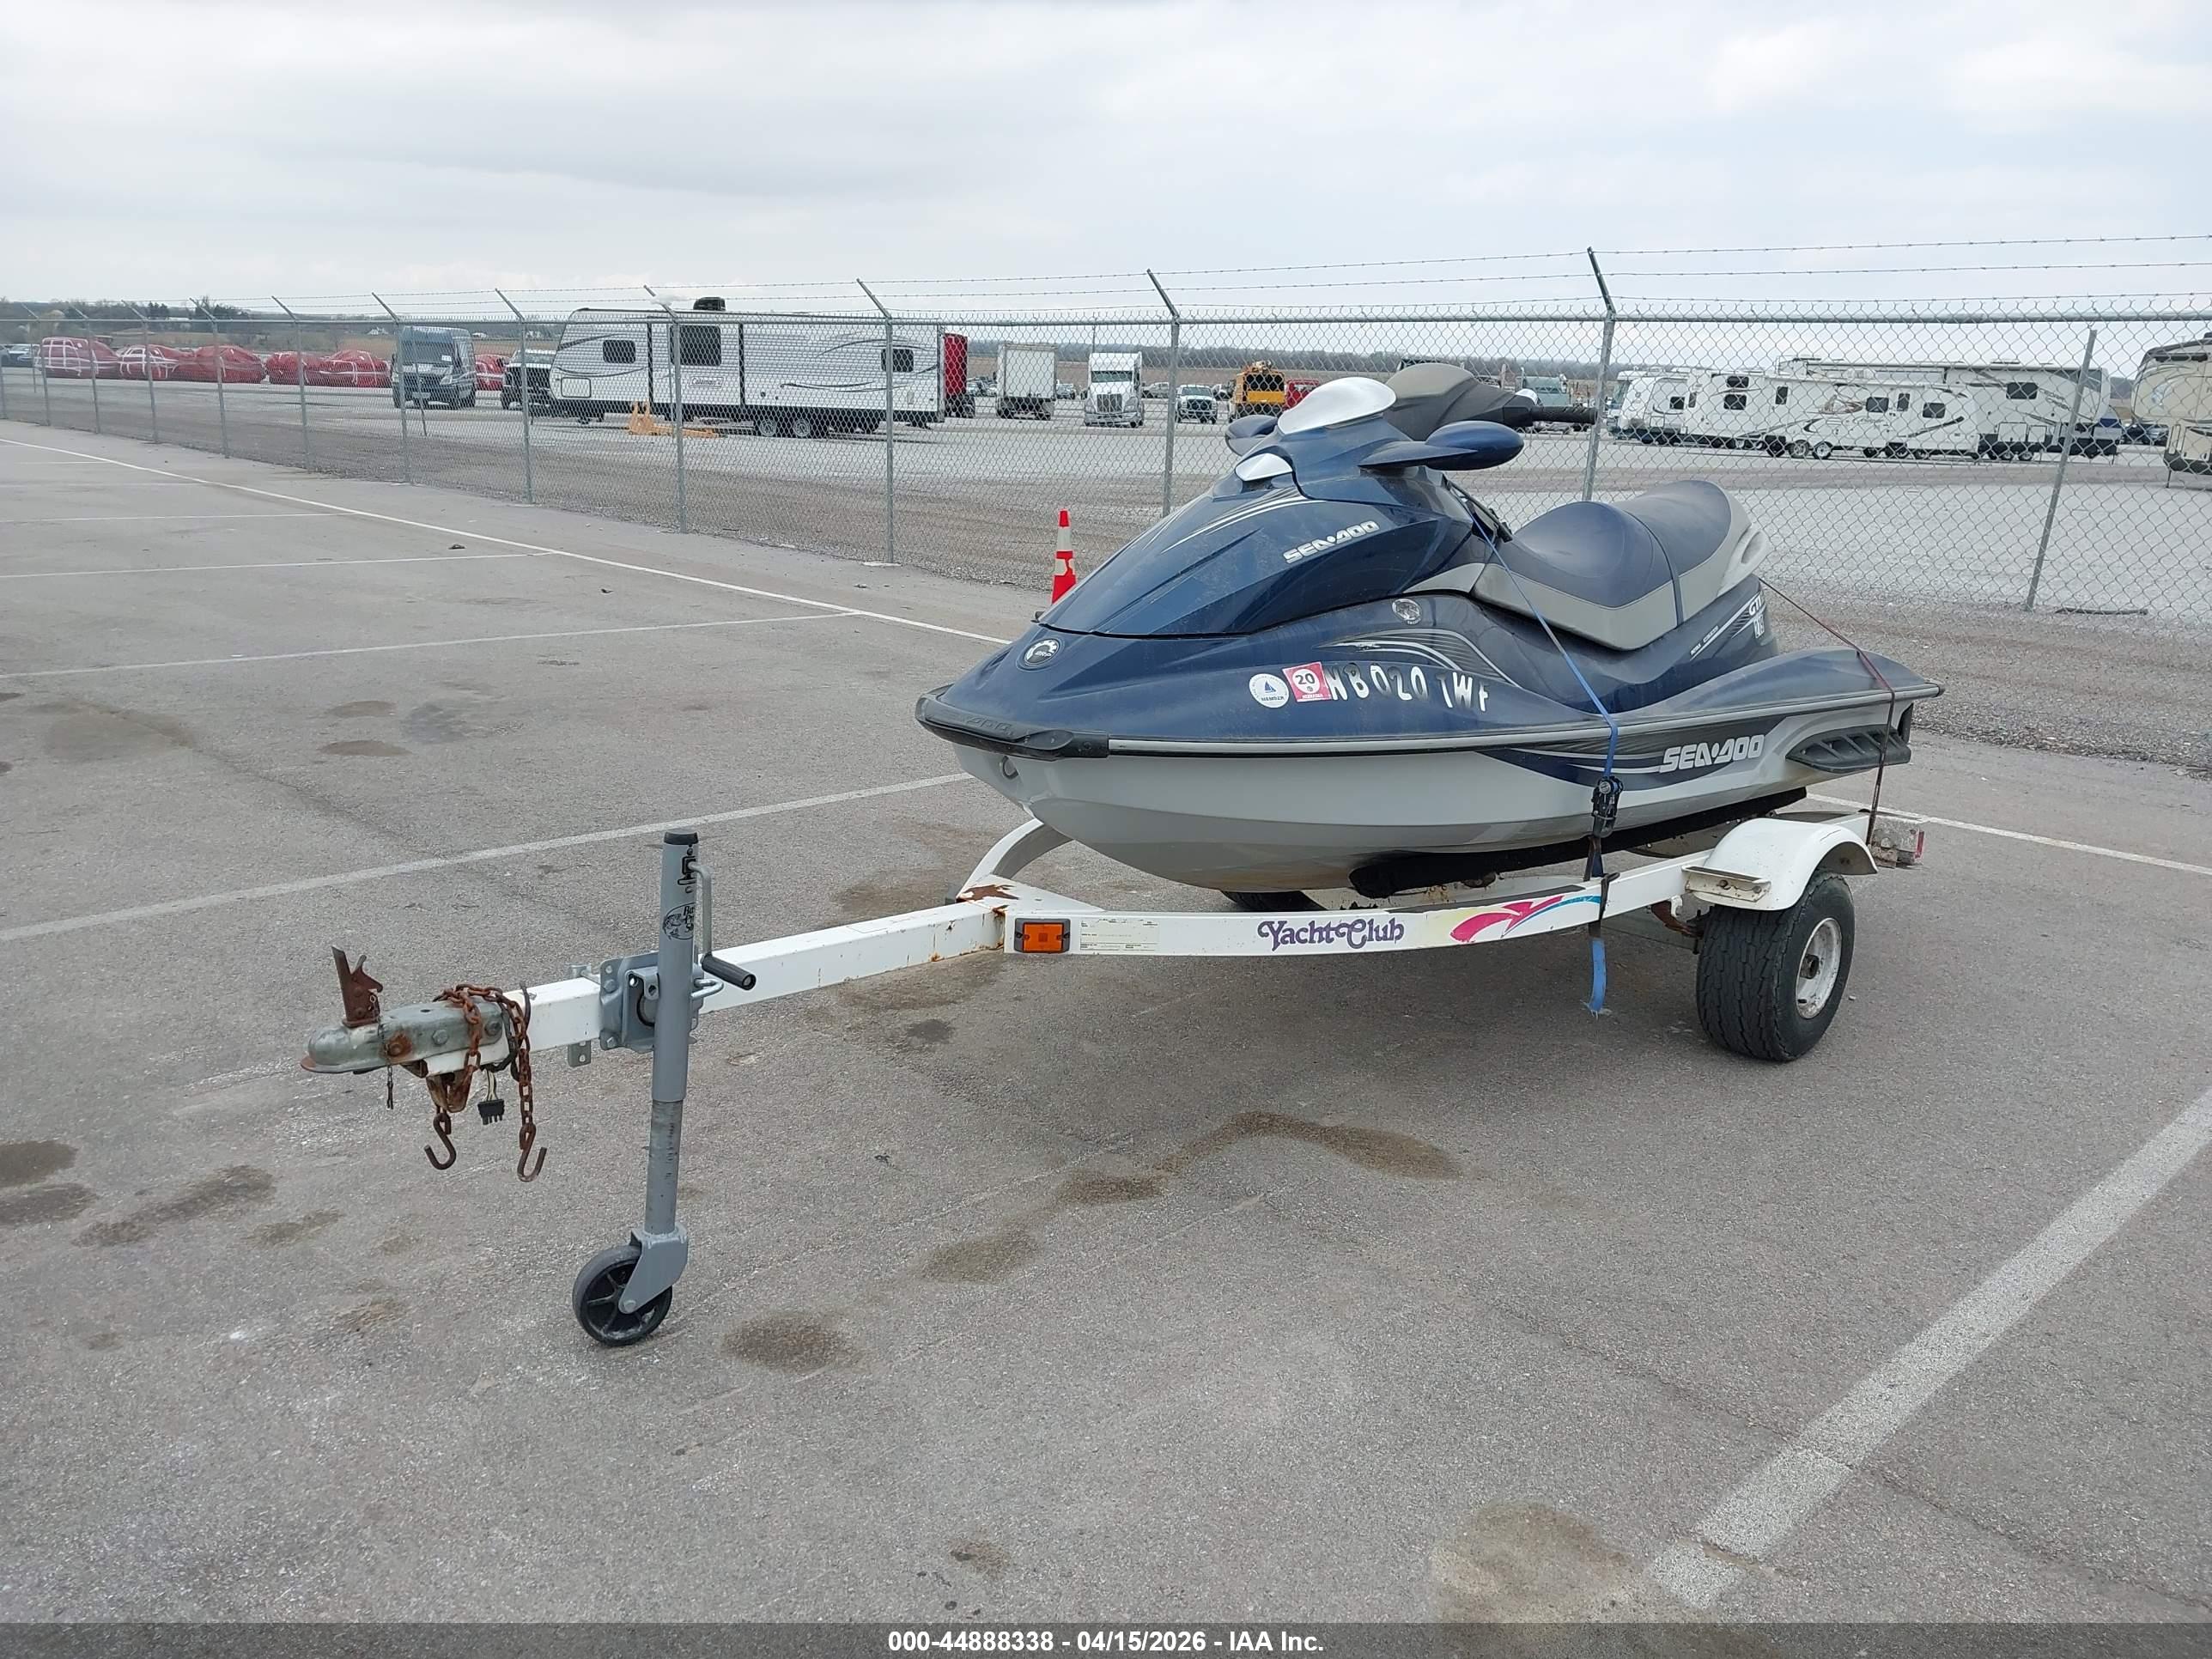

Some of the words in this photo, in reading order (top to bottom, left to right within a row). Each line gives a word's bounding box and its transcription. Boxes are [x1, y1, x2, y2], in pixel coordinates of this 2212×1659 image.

[1295, 672, 1315, 685] 20
[1257, 920, 1334, 951] Yacht
[1334, 917, 1405, 950] Club
